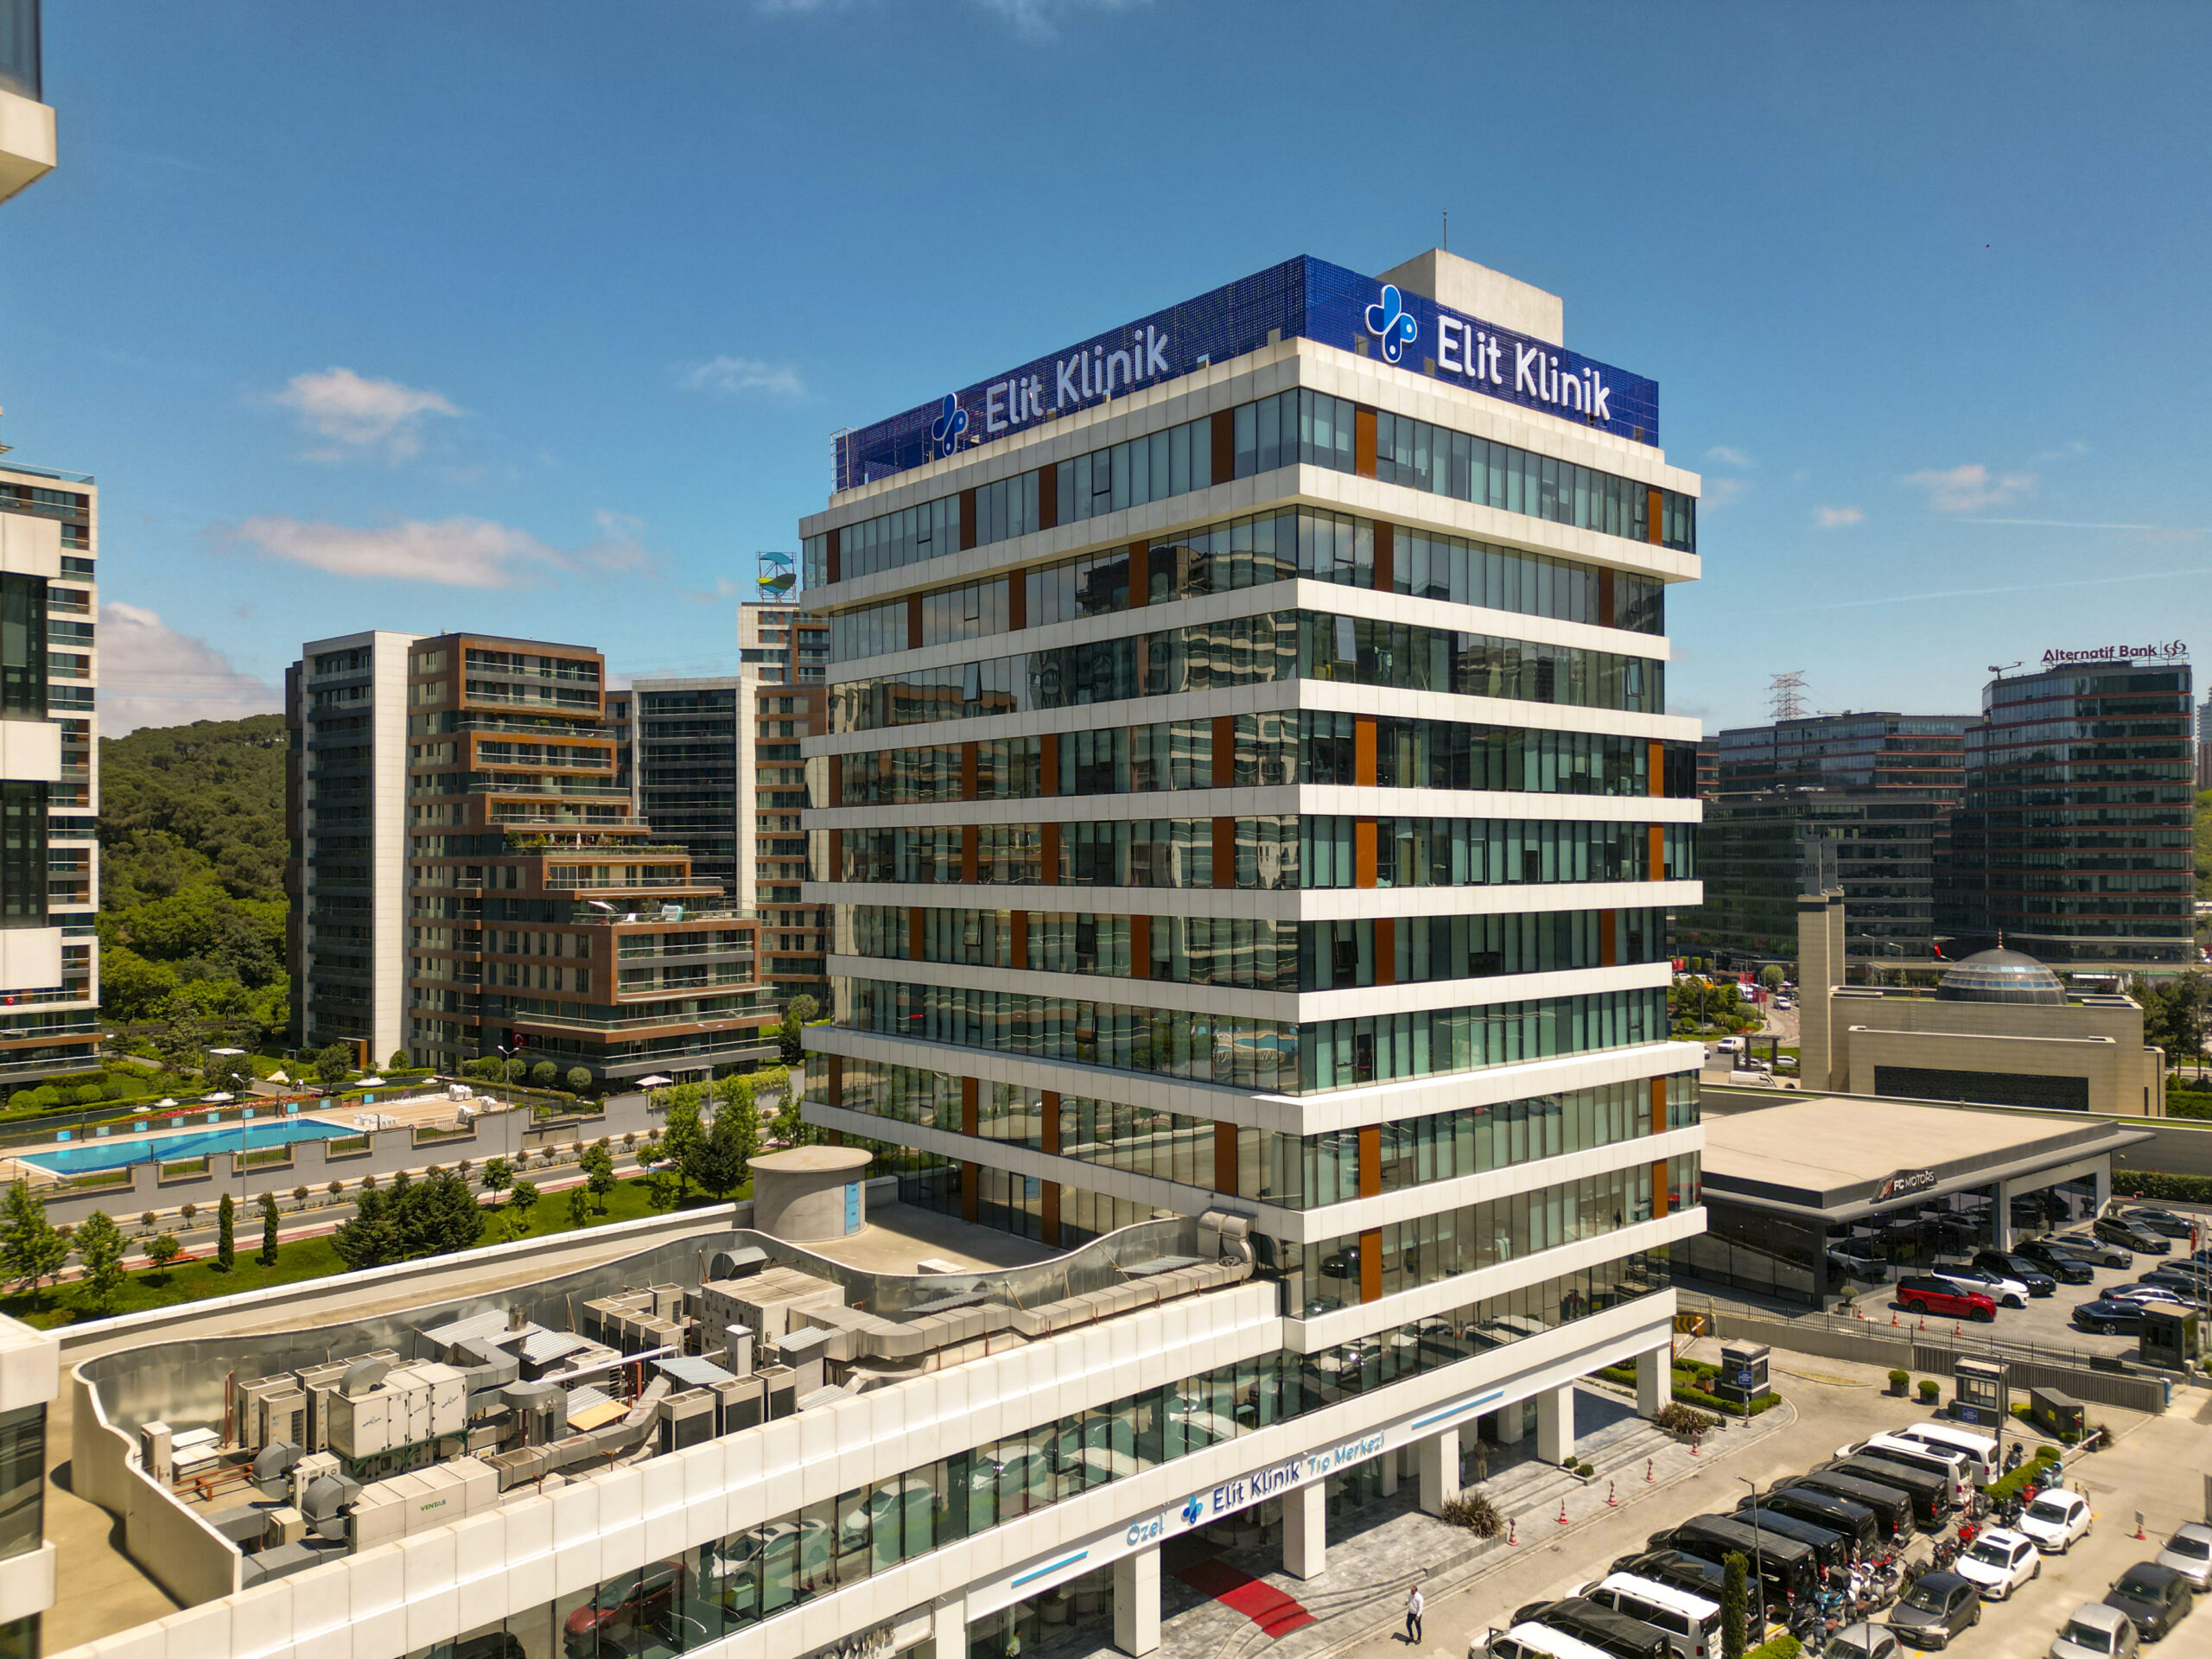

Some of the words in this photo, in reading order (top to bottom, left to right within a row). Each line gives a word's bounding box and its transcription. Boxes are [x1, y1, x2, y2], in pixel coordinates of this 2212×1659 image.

[986, 373, 1044, 433] Elit
[1056, 325, 1169, 408] Klinik
[1437, 315, 1503, 385] Elit
[1515, 342, 1611, 421] Klinik
[2042, 645, 2115, 662] Alternatif
[2119, 644, 2158, 658] Bank
[1894, 1179, 1904, 1192] FC
[1905, 1170, 1935, 1187] MOTORS
[420, 1499, 447, 1511] VENTAS
[1126, 1515, 1164, 1544] Özel
[1213, 1482, 1244, 1510] Elit
[1250, 1460, 1300, 1497] Klinik
[1335, 1431, 1384, 1465] Merkezi
